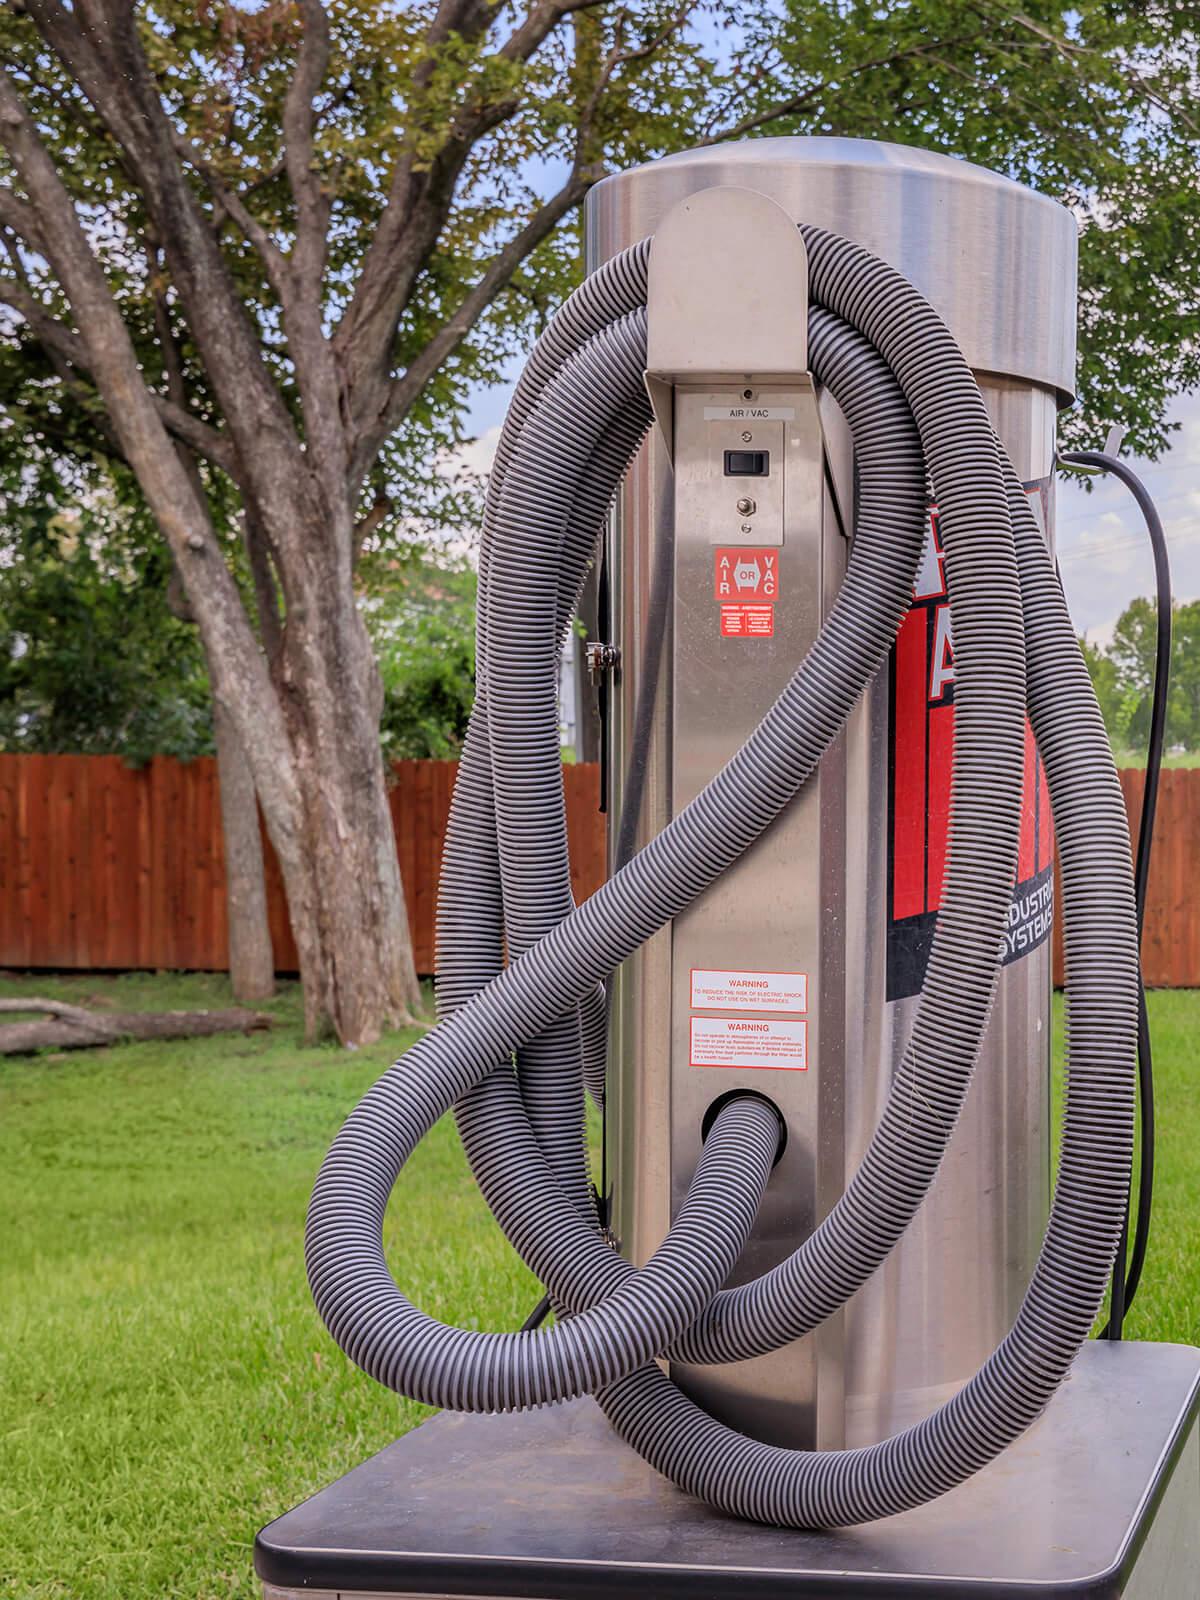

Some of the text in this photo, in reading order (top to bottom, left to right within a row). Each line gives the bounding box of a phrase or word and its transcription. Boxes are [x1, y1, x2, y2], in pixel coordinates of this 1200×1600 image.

[729, 409, 744, 417] AIR
[750, 409, 769, 418] VAC
[739, 570, 756, 580] OR
[729, 980, 769, 988] WARNING
[728, 1024, 769, 1032] WARNING
